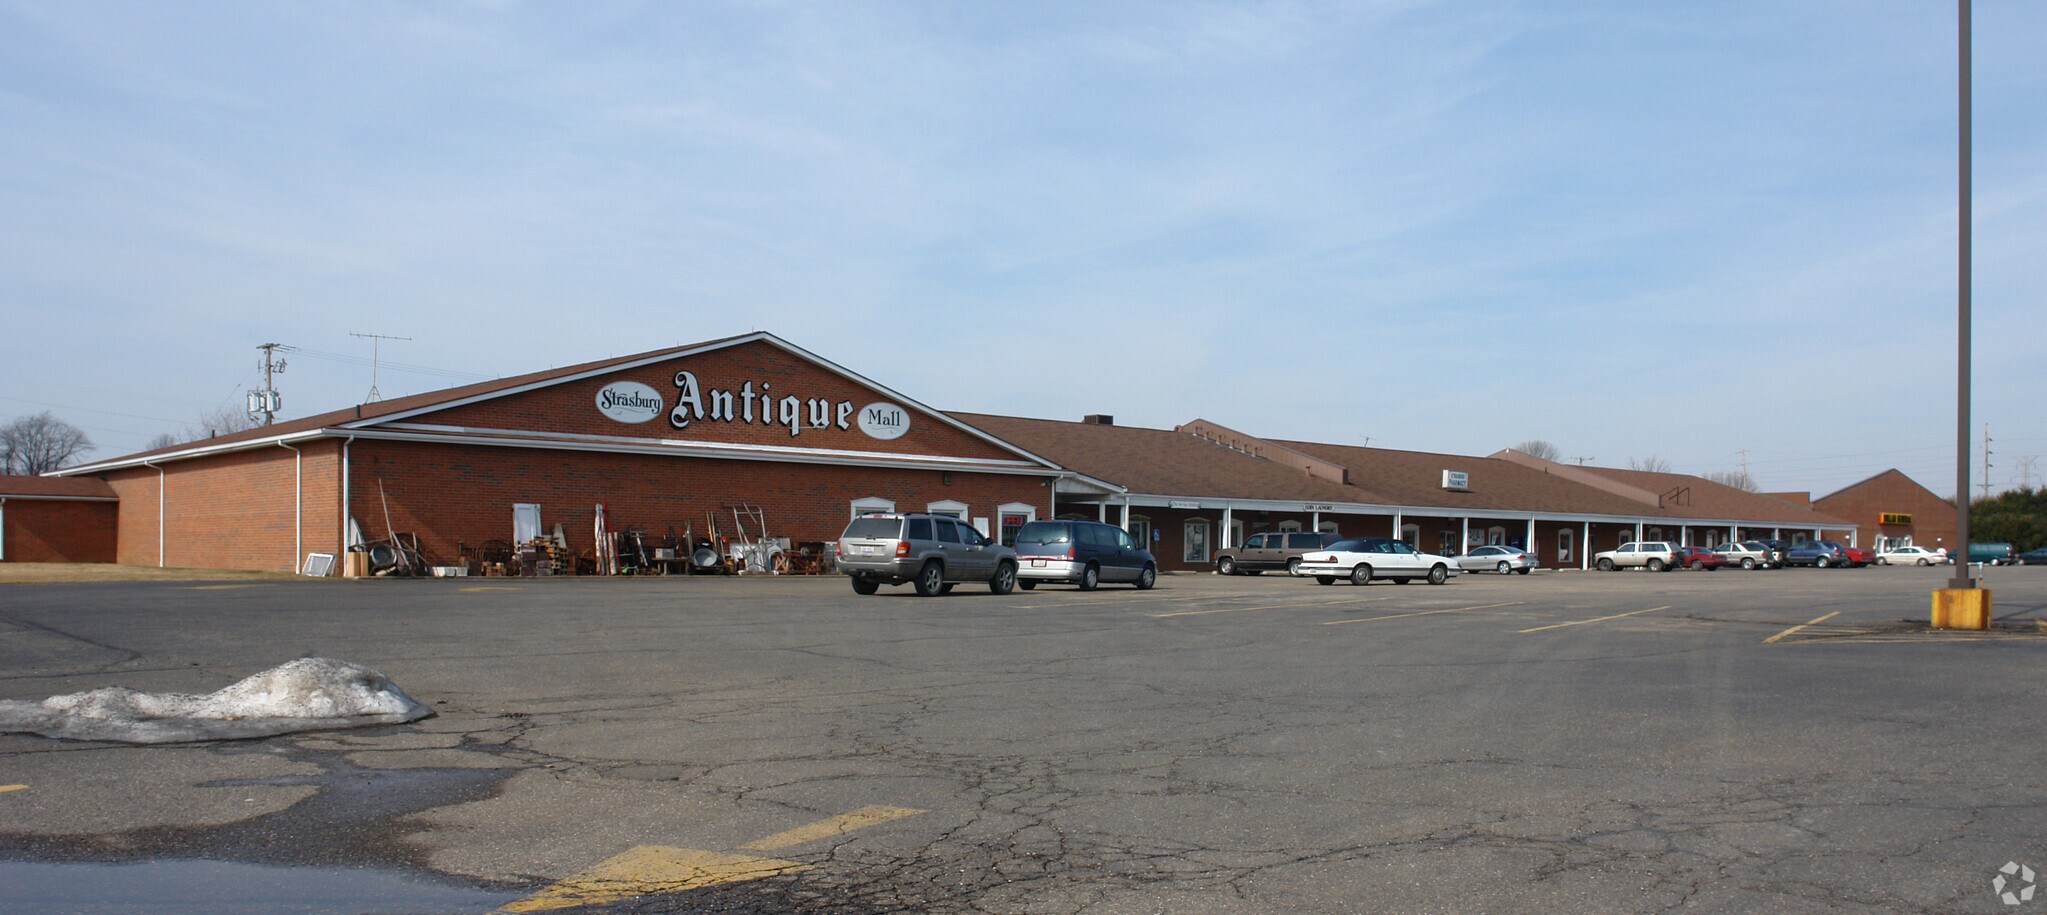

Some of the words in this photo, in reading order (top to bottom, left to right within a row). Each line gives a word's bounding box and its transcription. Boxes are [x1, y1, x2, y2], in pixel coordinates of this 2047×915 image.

[601, 387, 662, 414] Strasburg
[669, 370, 854, 438] Antique
[868, 408, 901, 427] Mall
